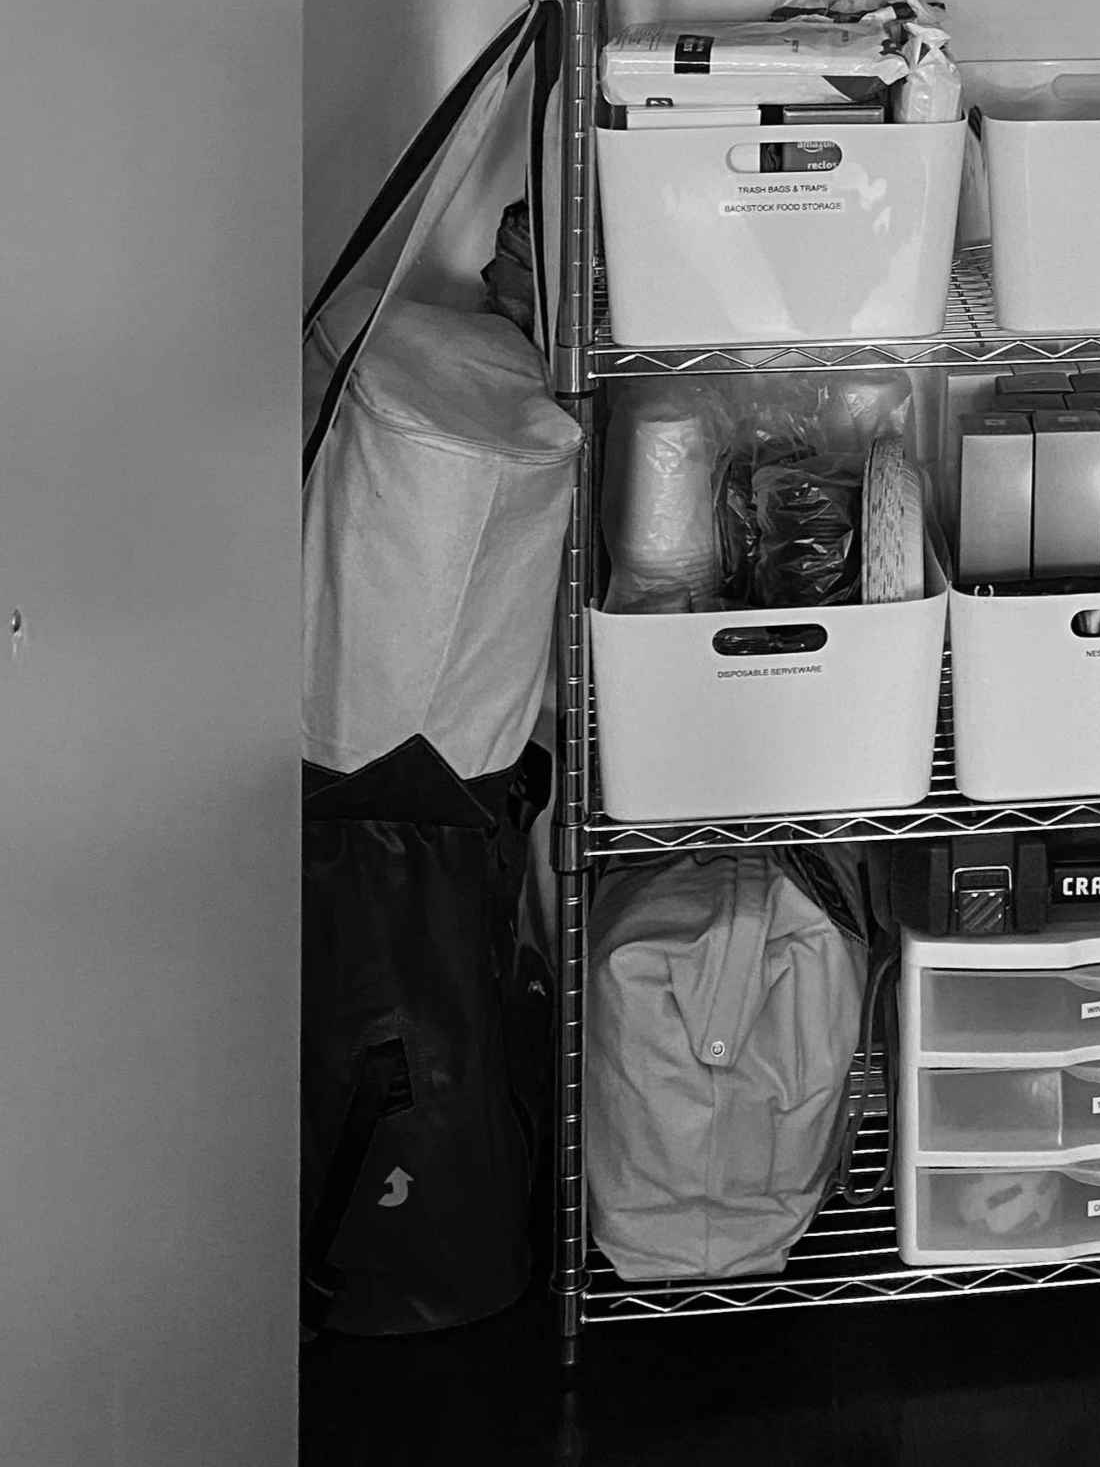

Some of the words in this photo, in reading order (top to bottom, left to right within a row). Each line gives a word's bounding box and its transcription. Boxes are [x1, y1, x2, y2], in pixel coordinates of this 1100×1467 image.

[738, 186, 766, 195] TRASH
[767, 185, 791, 194] BAGS
[792, 185, 799, 193] &
[799, 184, 828, 193] TRAPS
[724, 204, 775, 213] BACKSTOCK
[776, 203, 800, 212] FOOD
[801, 202, 843, 211] STORAGE
[717, 669, 768, 679] DISPOSABLE
[769, 665, 822, 676] SERVEWARE
